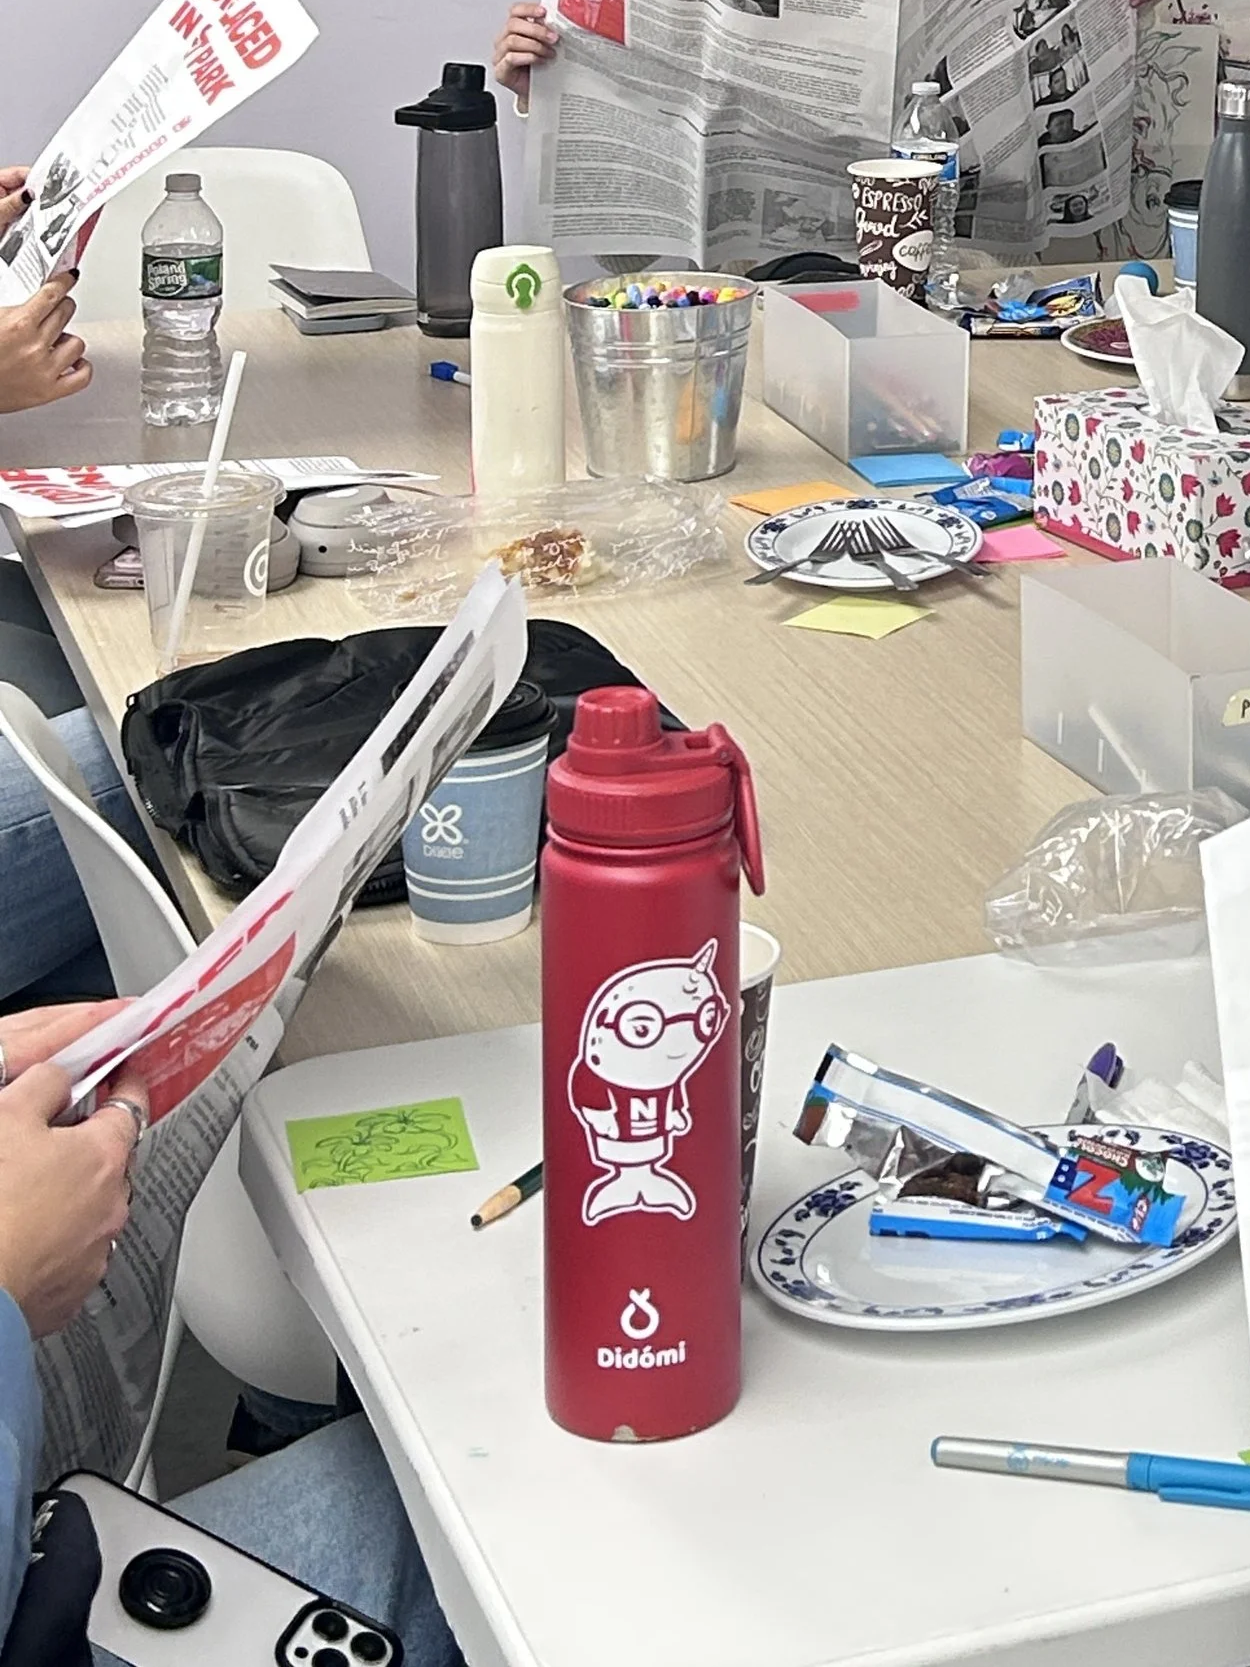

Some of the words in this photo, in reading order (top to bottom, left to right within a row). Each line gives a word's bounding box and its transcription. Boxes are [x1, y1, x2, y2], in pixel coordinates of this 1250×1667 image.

[168, 0, 203, 41] IN
[190, 48, 236, 107] PARK
[862, 187, 923, 213] ESPRESSO
[855, 207, 900, 244] good
[147, 260, 185, 277] Poland
[148, 274, 187, 291] Spring
[630, 1097, 658, 1124] N
[1067, 1158, 1121, 1215] Z
[597, 1341, 687, 1374] Didómi
